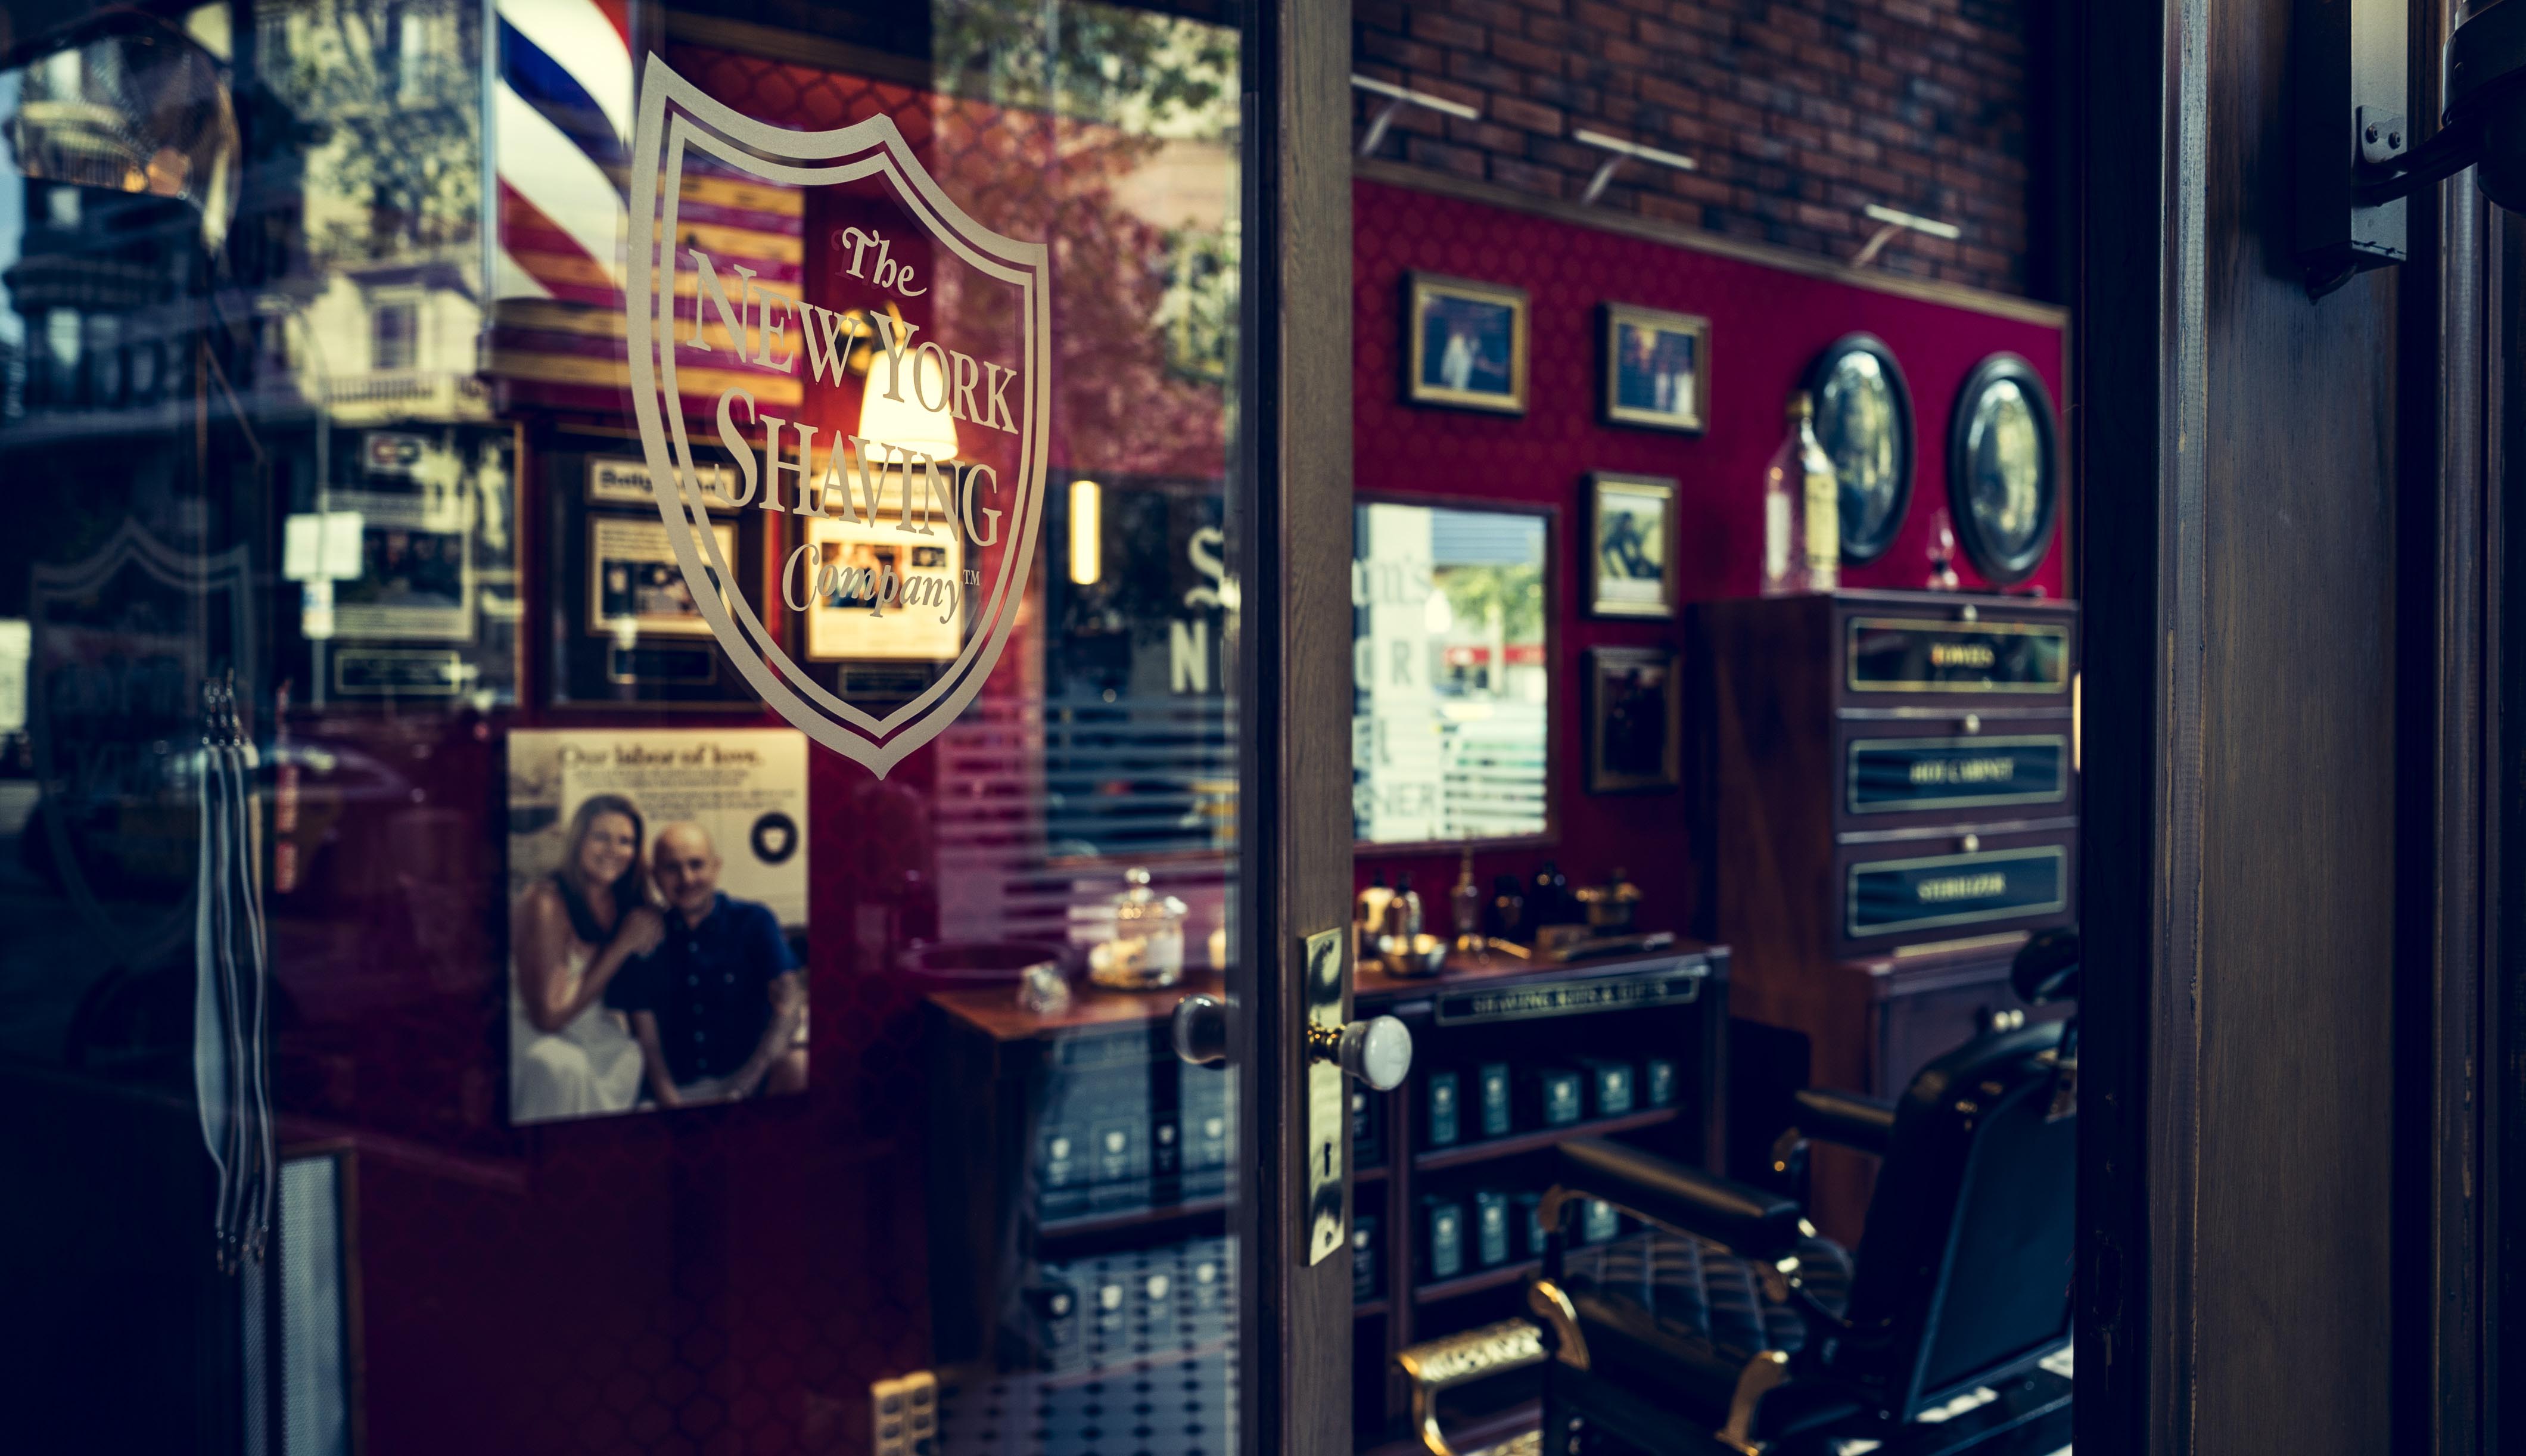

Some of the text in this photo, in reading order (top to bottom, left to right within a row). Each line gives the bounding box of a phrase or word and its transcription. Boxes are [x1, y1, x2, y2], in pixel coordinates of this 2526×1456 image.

[686, 248, 1019, 435] NEW YORK
[841, 226, 927, 297] The
[714, 387, 1003, 547] SHAVING
